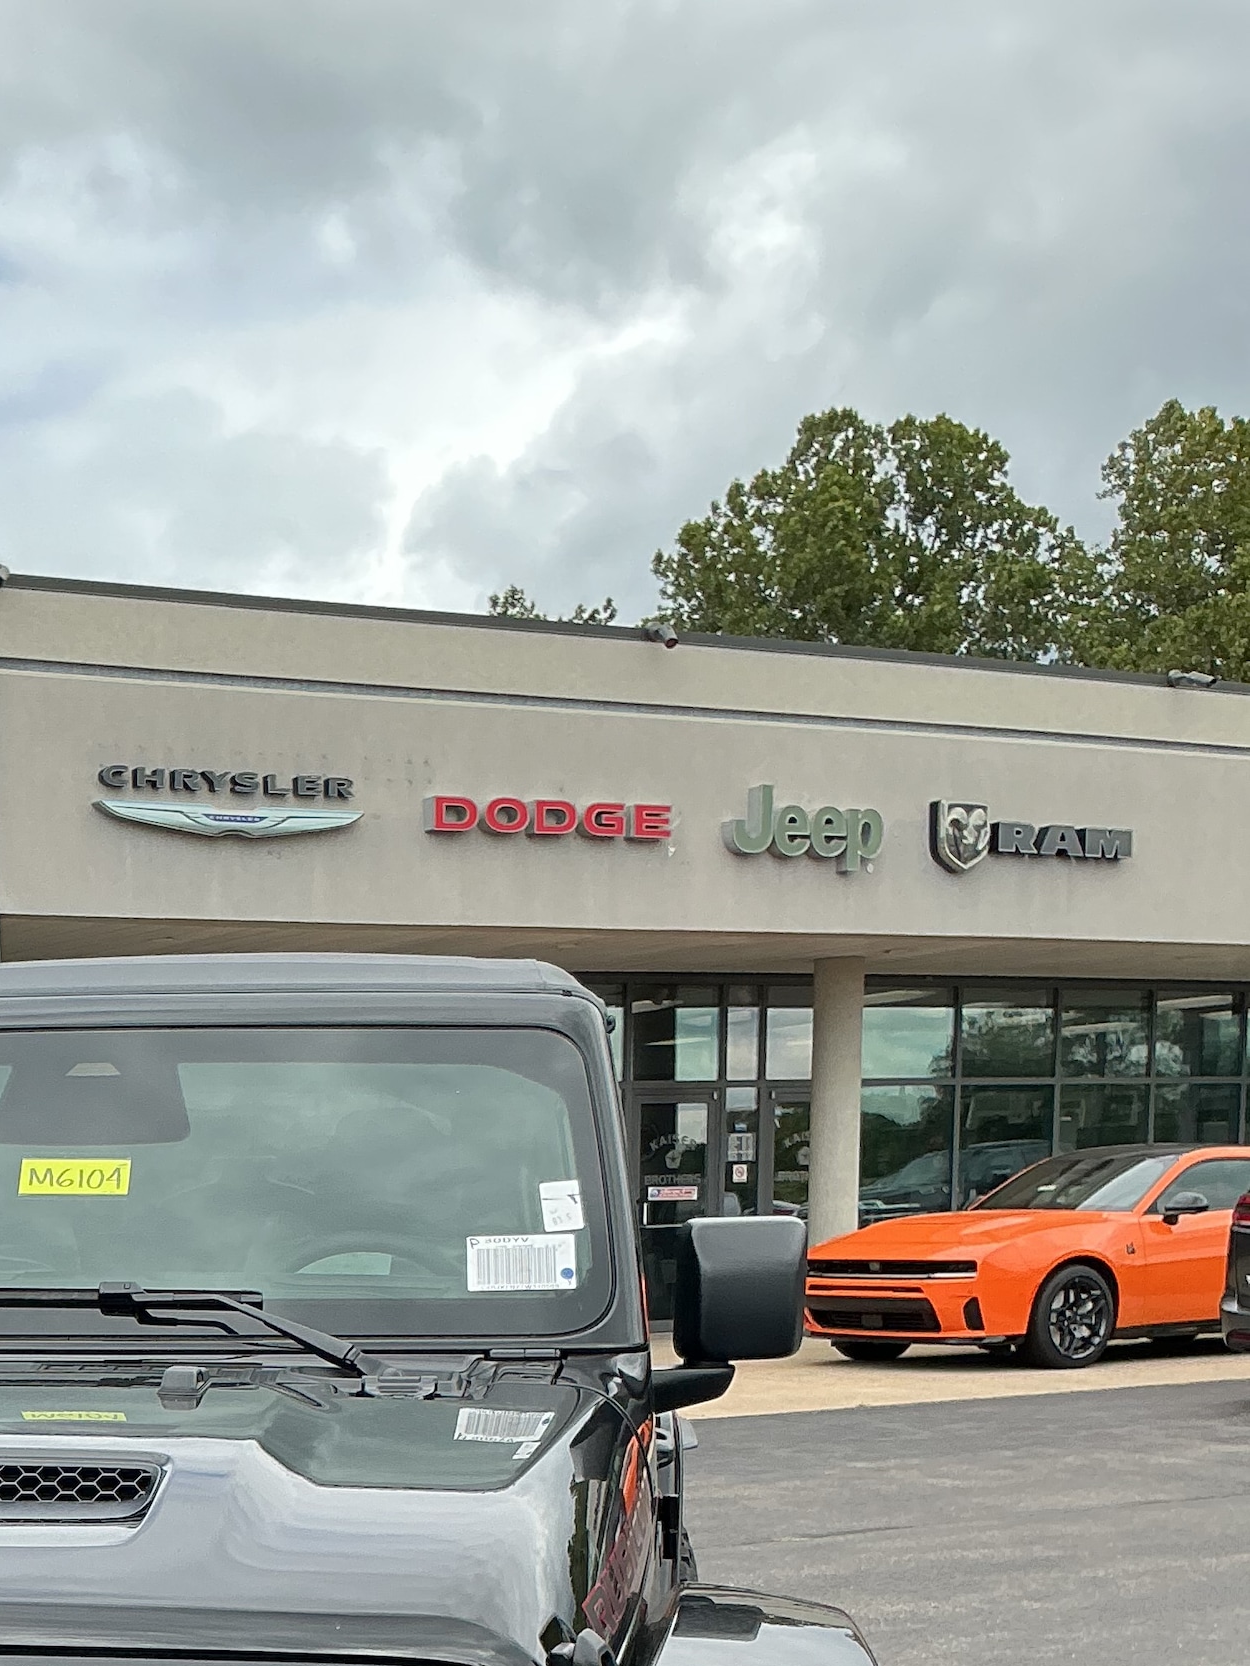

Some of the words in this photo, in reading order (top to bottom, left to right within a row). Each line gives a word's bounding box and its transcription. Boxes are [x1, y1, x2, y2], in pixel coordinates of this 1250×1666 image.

[98, 764, 356, 799] CHRYSLER
[424, 795, 672, 840] DODGE
[722, 784, 884, 874] Jeep
[990, 820, 1133, 858] RAM
[28, 1167, 121, 1190] M6104
[644, 1173, 702, 1186] BROTHERS
